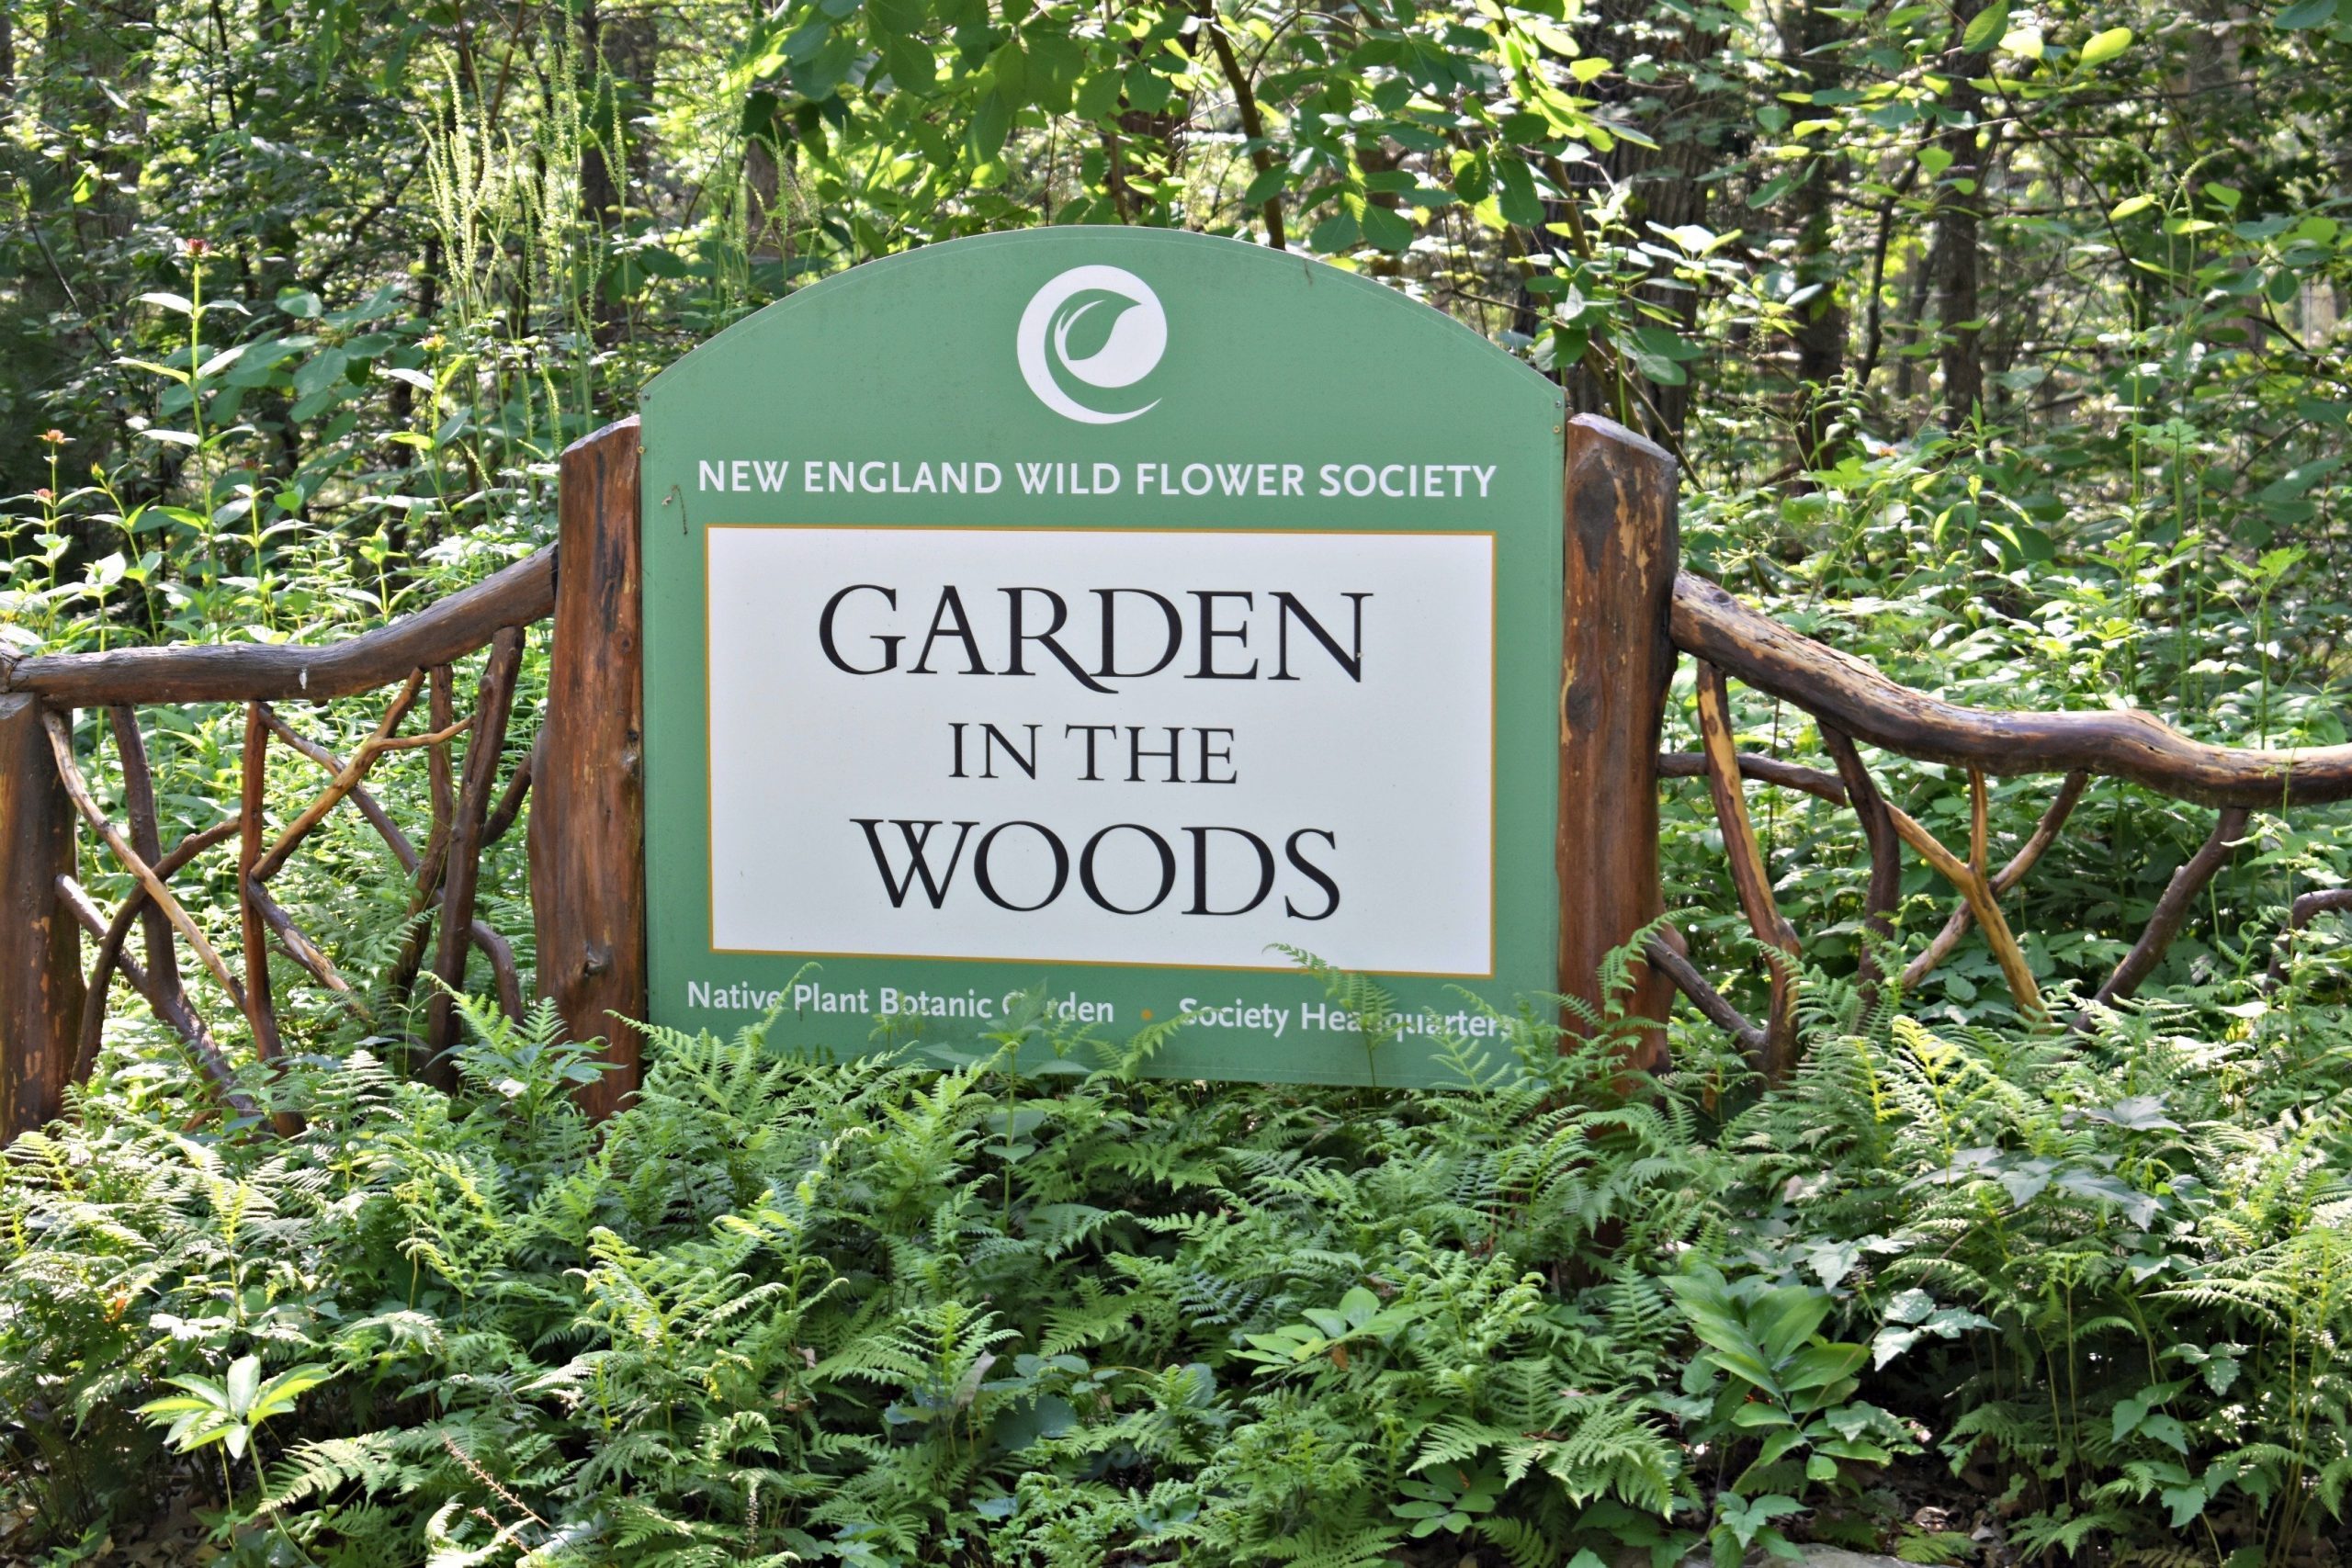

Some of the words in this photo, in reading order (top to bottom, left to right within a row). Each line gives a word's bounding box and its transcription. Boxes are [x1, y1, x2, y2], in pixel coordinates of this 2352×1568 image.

[698, 459, 790, 493] NEW
[804, 460, 1002, 494] ENGLAND
[1014, 462, 1121, 495] WILD
[1136, 463, 1305, 497] FLOWER
[1318, 464, 1498, 498] SOCIETY
[819, 584, 1374, 694] GARDEN
[948, 722, 1043, 780] IN
[1065, 724, 1238, 784] THE
[849, 818, 1340, 921] WOODS
[688, 980, 783, 1010] Native
[794, 982, 869, 1014] Plant
[880, 987, 993, 1019] Botanic
[1001, 991, 1114, 1022] rden
[1179, 998, 1291, 1038] Society
[1301, 1002, 1513, 1043] Heaquarter
